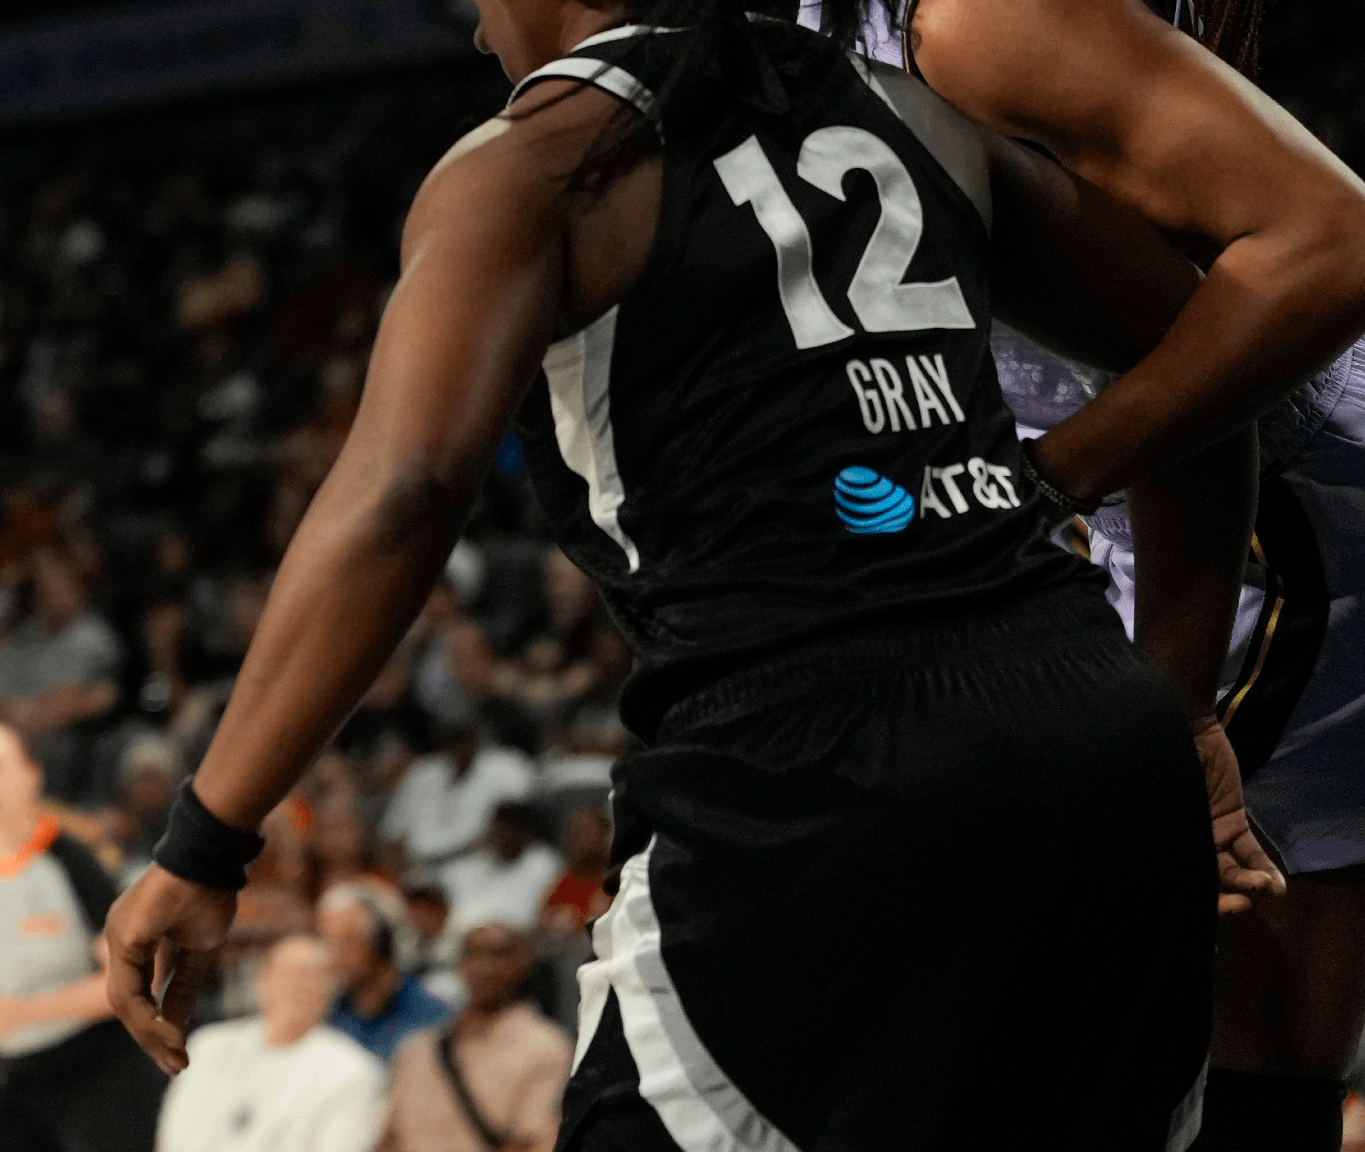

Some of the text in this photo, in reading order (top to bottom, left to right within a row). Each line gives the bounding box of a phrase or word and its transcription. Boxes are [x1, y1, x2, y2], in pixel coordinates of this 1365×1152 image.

[713, 125, 976, 350] 12
[846, 353, 965, 435] GRAY
[919, 456, 1022, 519] AT&T
